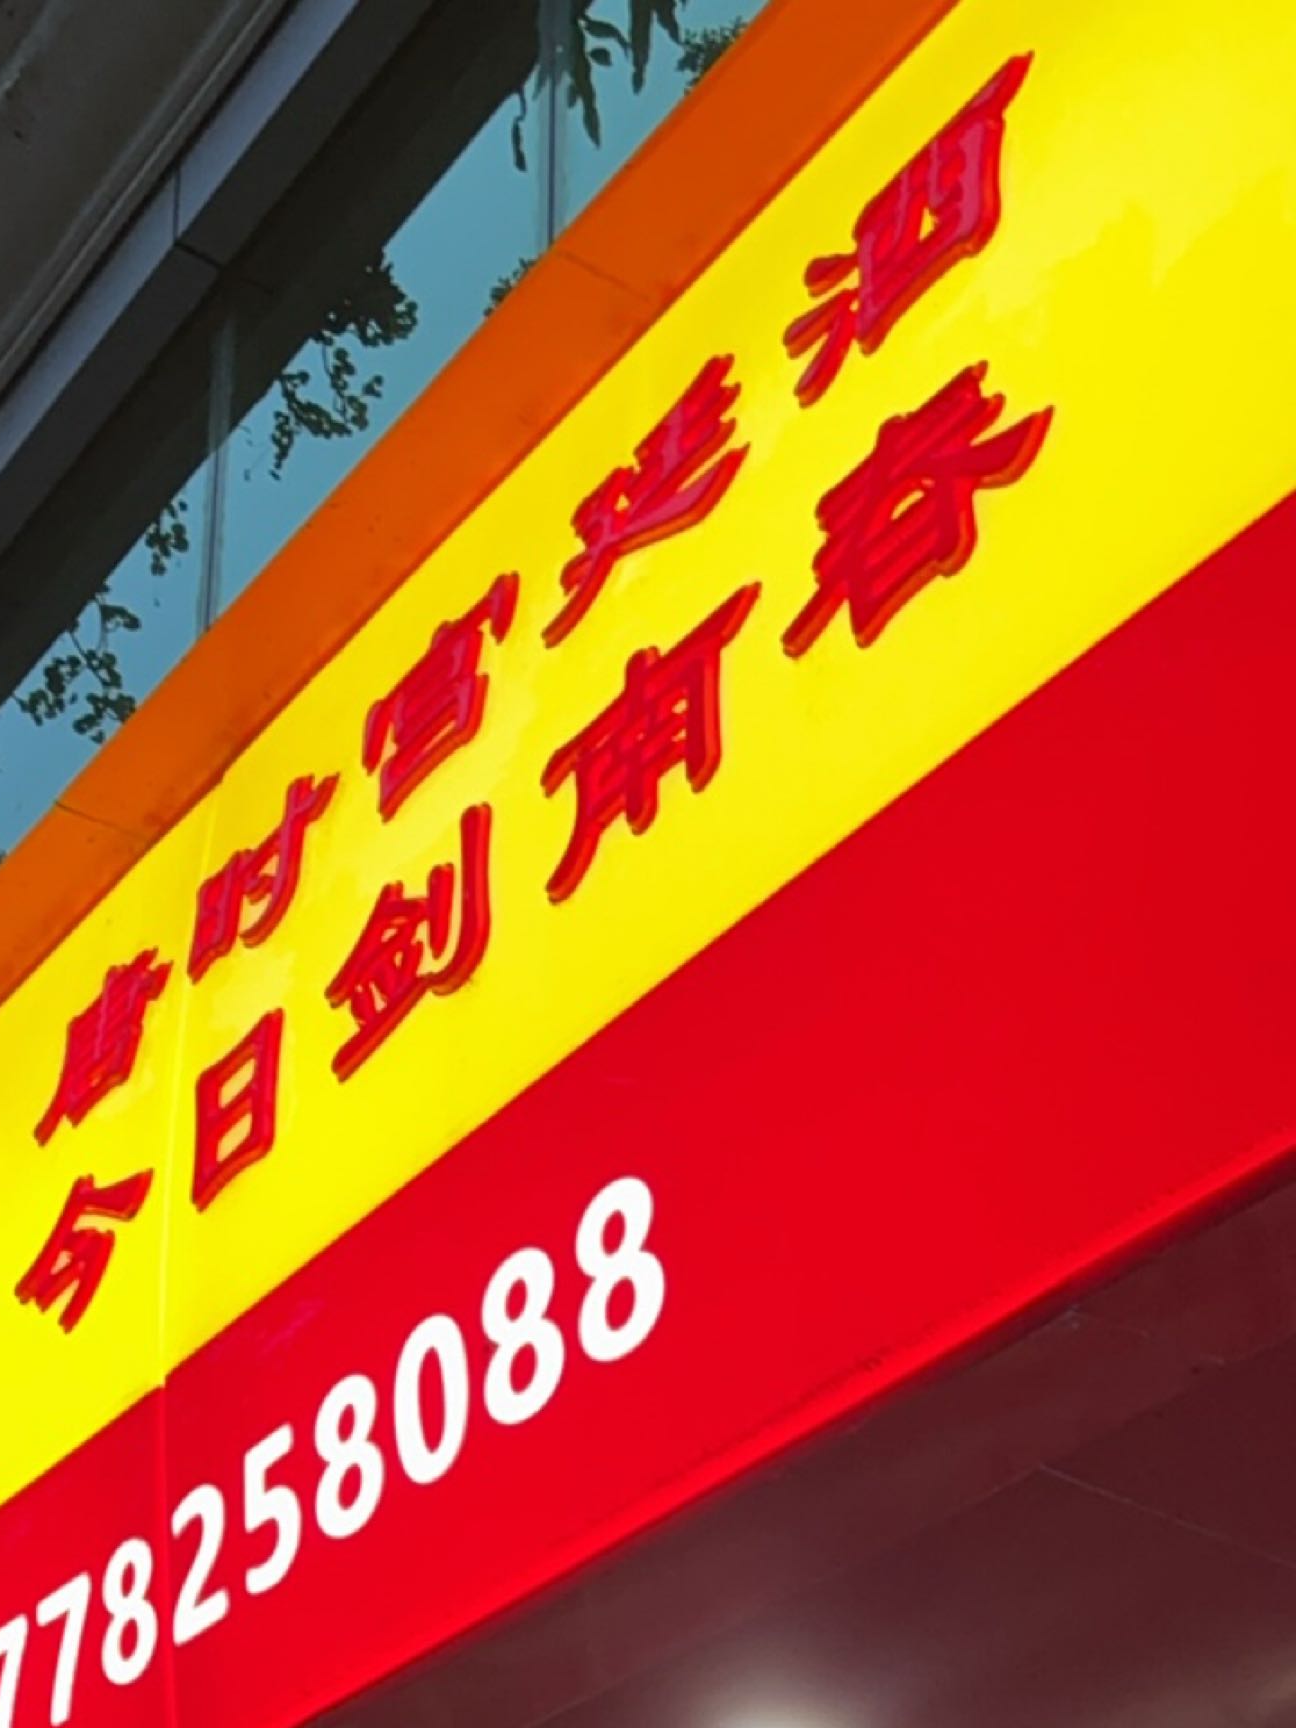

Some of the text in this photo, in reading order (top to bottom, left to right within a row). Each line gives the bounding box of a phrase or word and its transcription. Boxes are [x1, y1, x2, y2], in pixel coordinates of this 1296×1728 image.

[15, 361, 1055, 1334] 今日剑南春
[34, 51, 1035, 1147] 唐时宫廷酒
